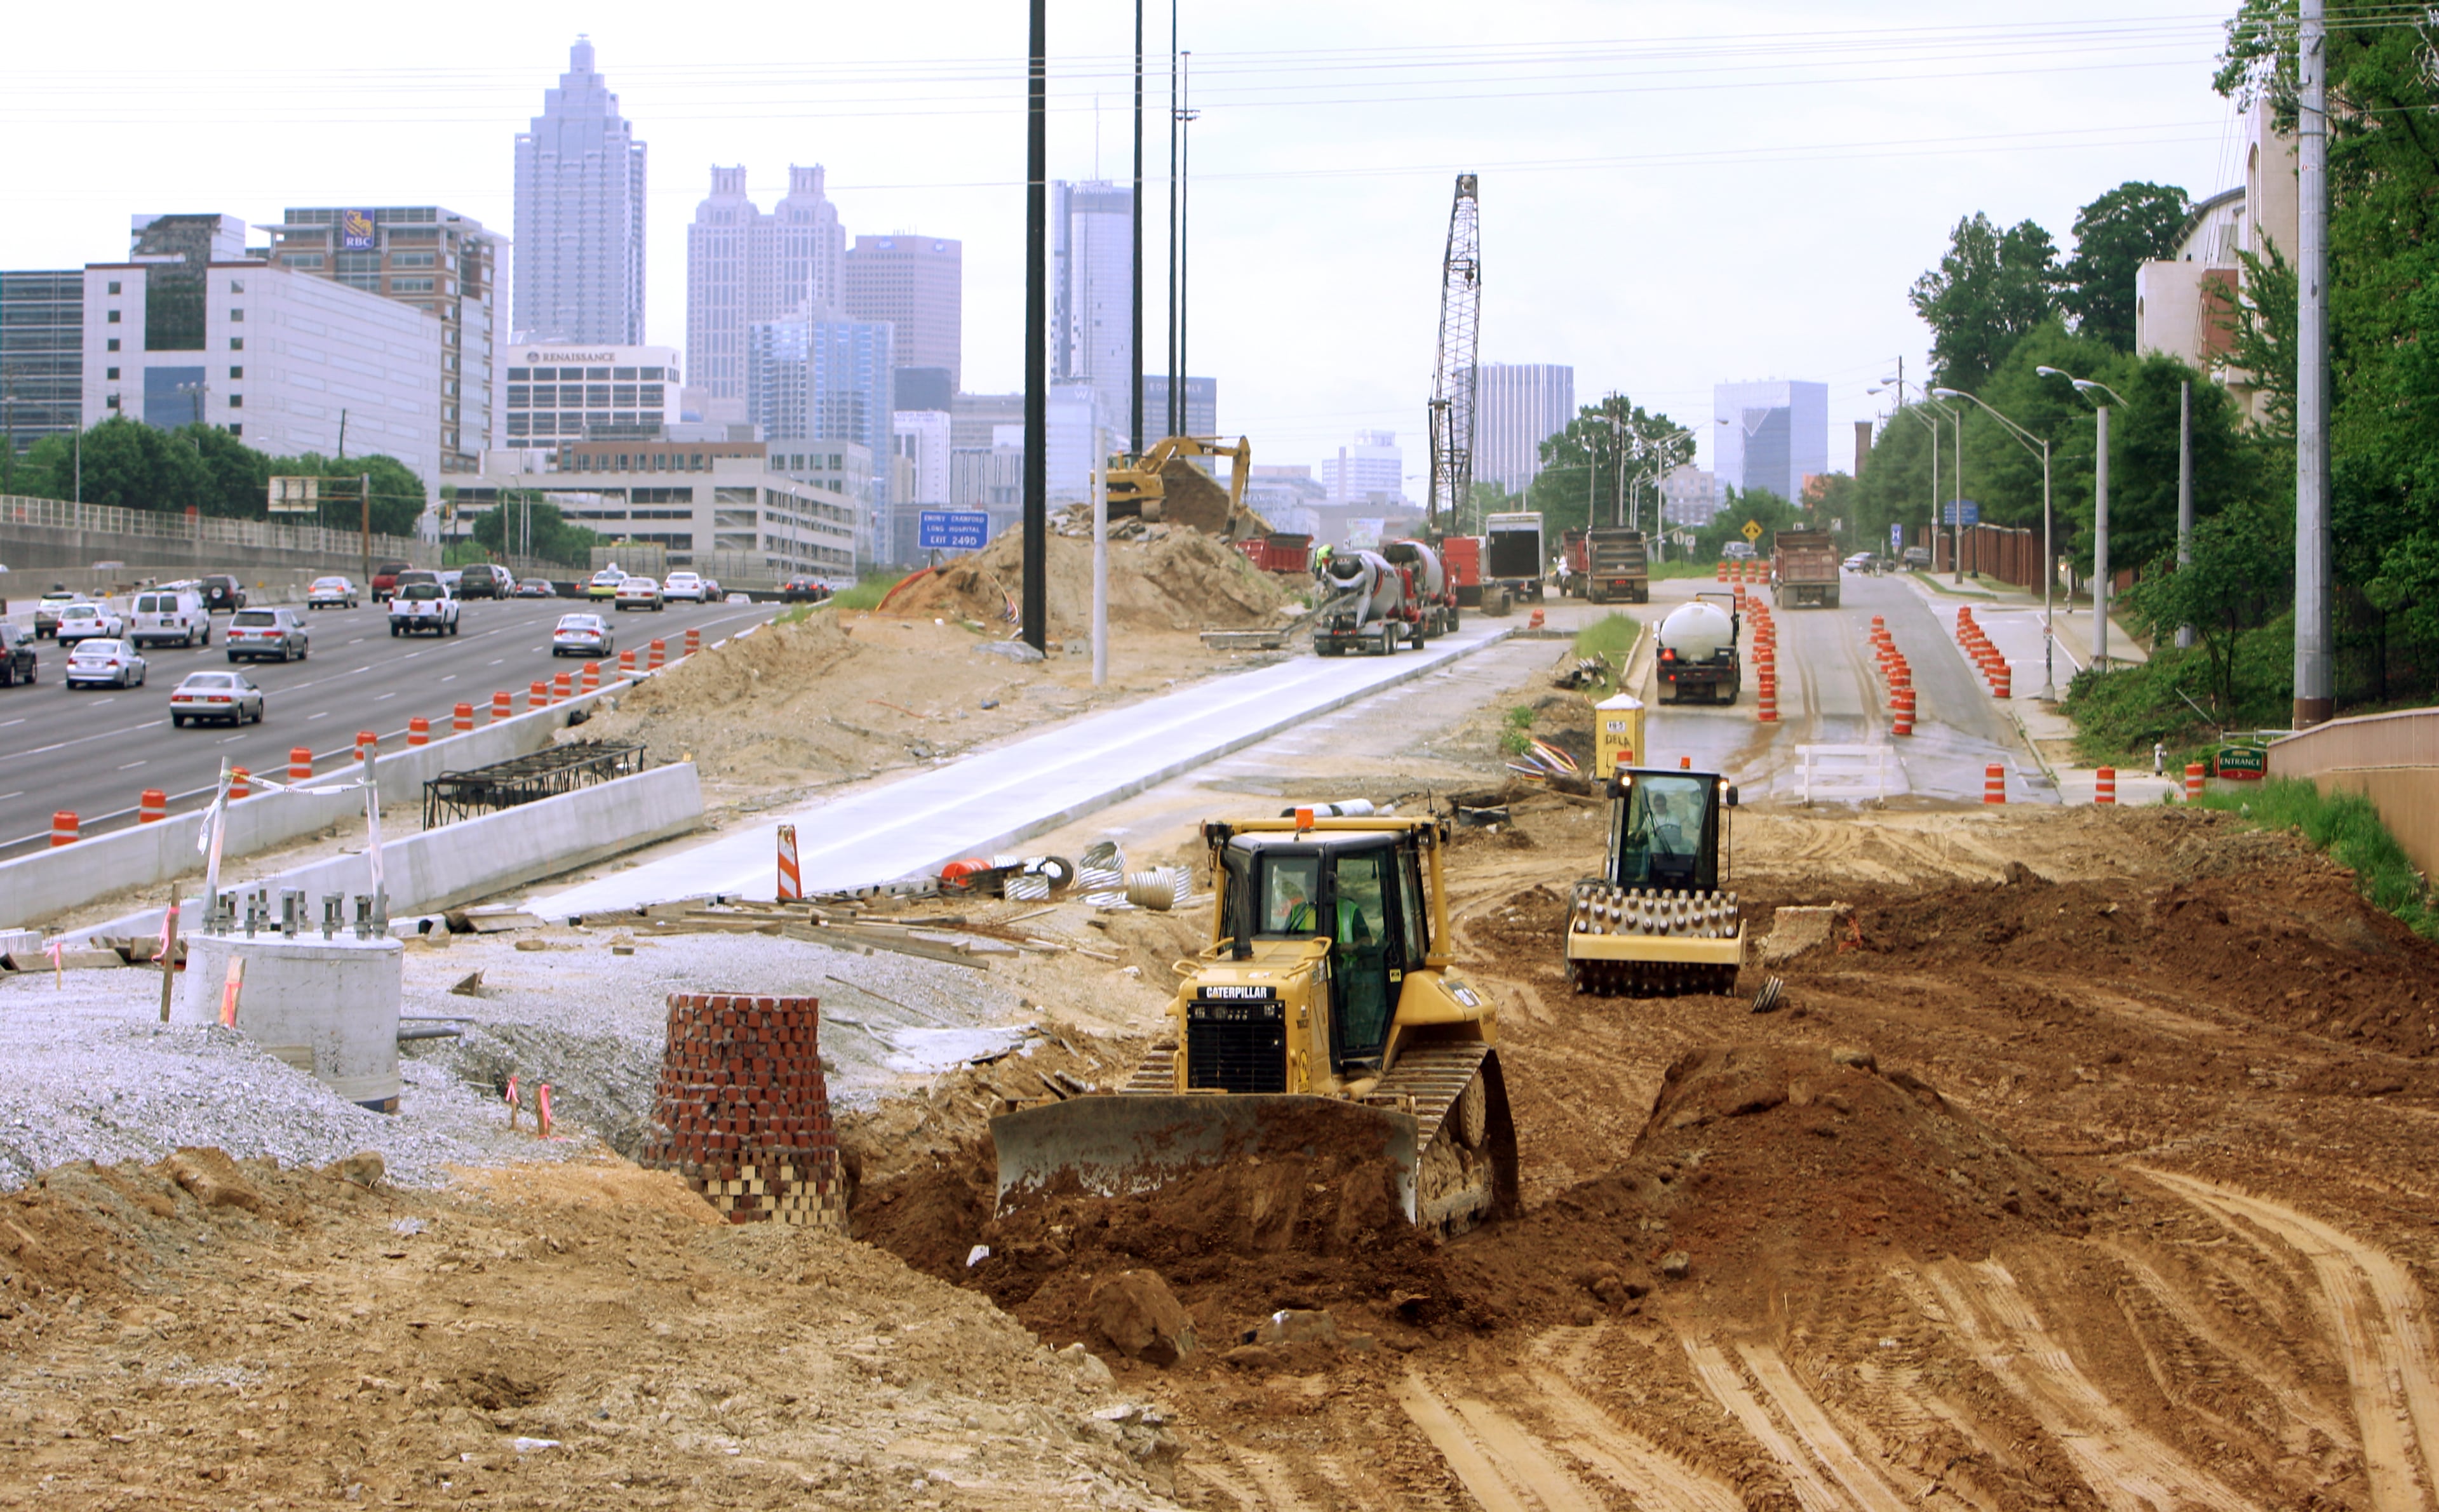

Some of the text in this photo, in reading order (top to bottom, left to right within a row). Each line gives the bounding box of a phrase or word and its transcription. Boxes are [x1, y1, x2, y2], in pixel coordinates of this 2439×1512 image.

[346, 237, 371, 246] RBC
[542, 352, 615, 361] RENAISSANCE
[1149, 383, 1202, 392] EQUBLE
[1075, 390, 1088, 399] W
[1892, 530, 1900, 540] H
[931, 536, 977, 545] EXIT 249D
[2220, 758, 2259, 766] ENTRANCE
[1206, 986, 1267, 999] CATERPILLAR
